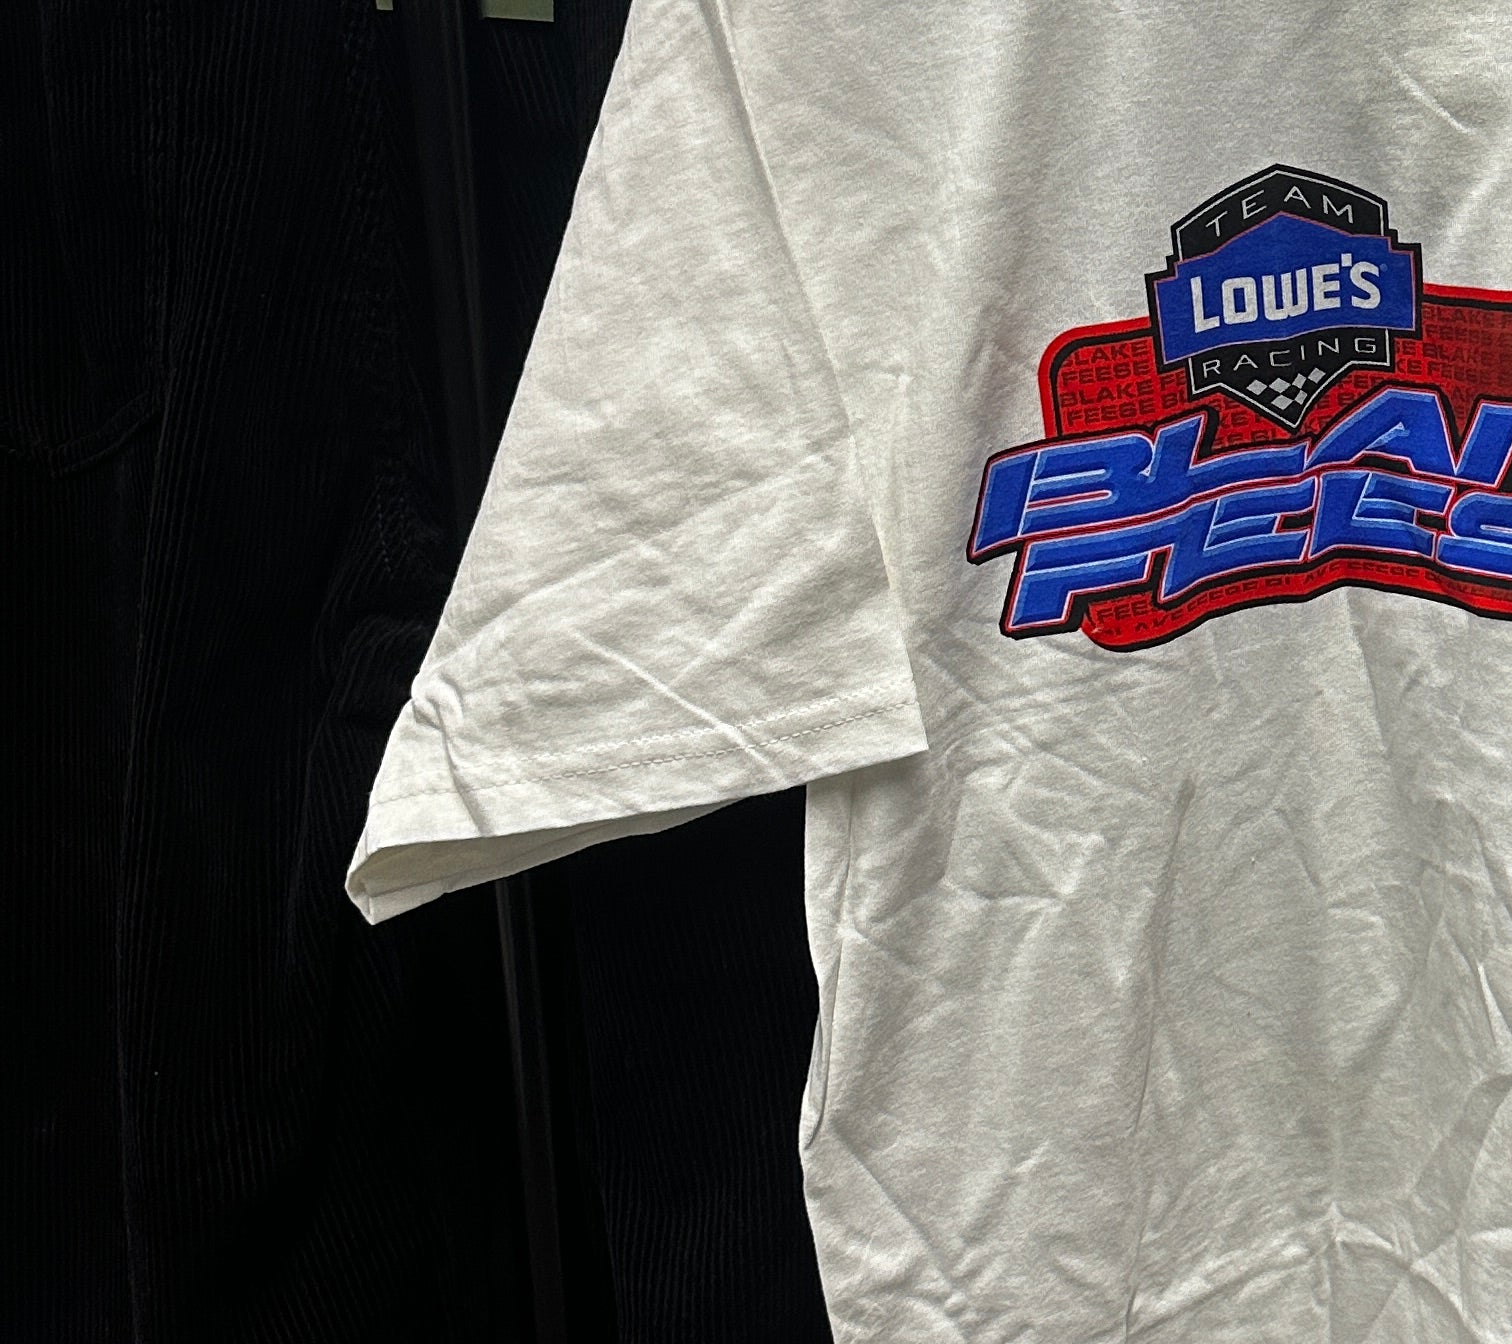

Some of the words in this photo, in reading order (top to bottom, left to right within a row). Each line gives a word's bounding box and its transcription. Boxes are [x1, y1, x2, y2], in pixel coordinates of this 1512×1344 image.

[1205, 186, 1354, 237] TEAM
[1190, 253, 1382, 334] LOWE'S
[1202, 337, 1377, 379] RACING
